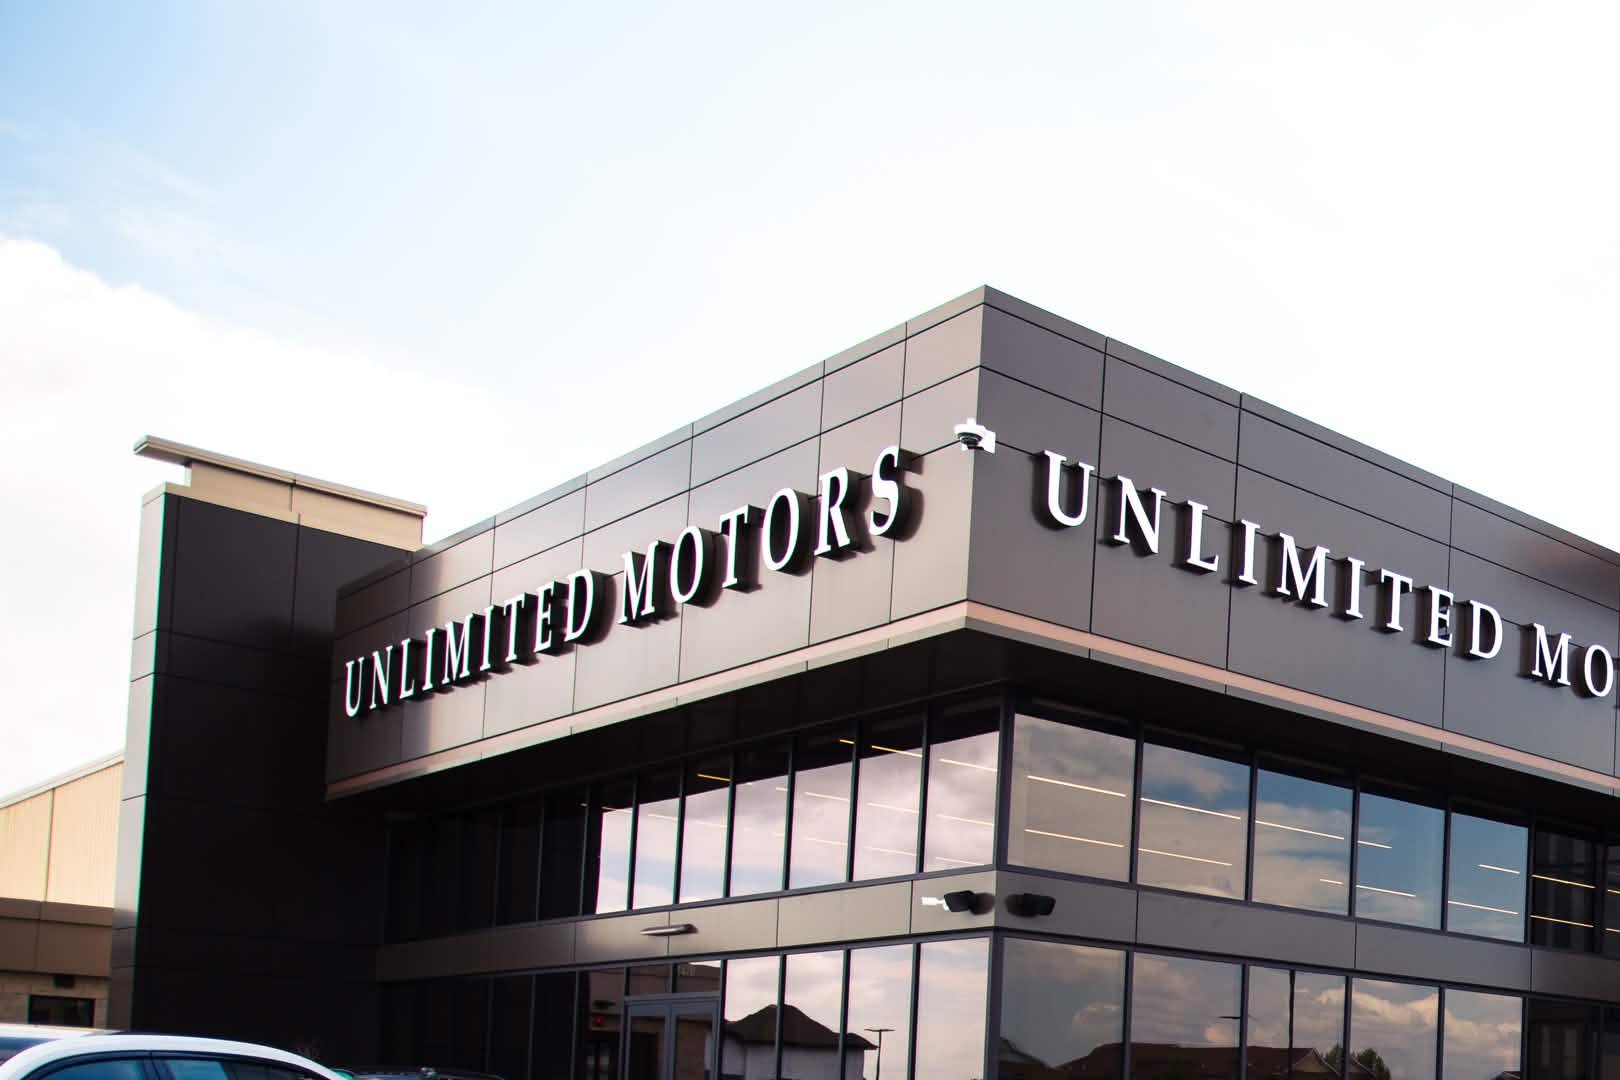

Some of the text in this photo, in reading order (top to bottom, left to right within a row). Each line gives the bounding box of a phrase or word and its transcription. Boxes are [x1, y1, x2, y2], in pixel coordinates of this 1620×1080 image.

[345, 445, 900, 717] UNLIMITED MOTORS
[1042, 450, 1503, 659] UNLIMITED
